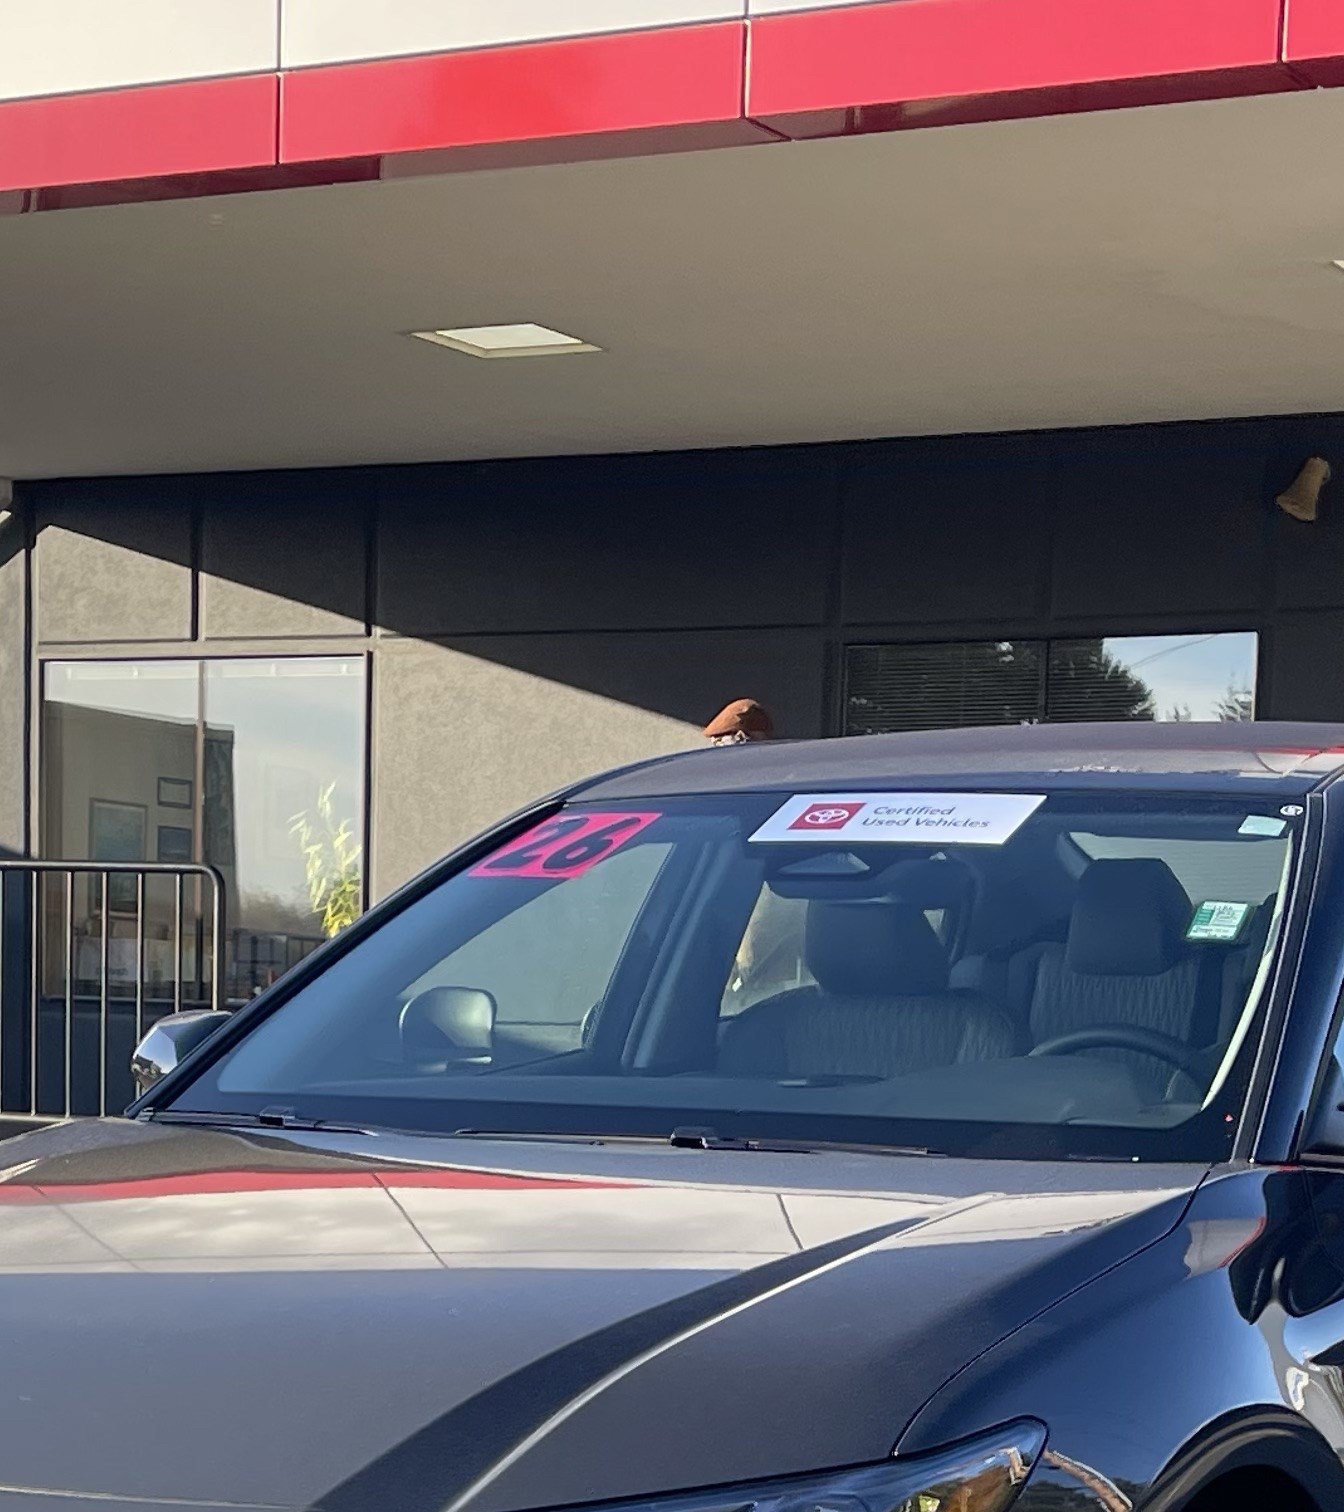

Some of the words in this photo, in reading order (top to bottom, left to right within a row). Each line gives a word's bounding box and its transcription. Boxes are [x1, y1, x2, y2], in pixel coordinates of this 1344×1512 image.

[873, 806, 956, 815] Certified
[862, 817, 911, 827] Used
[915, 817, 990, 828] Vehicles
[484, 815, 642, 870] 26
